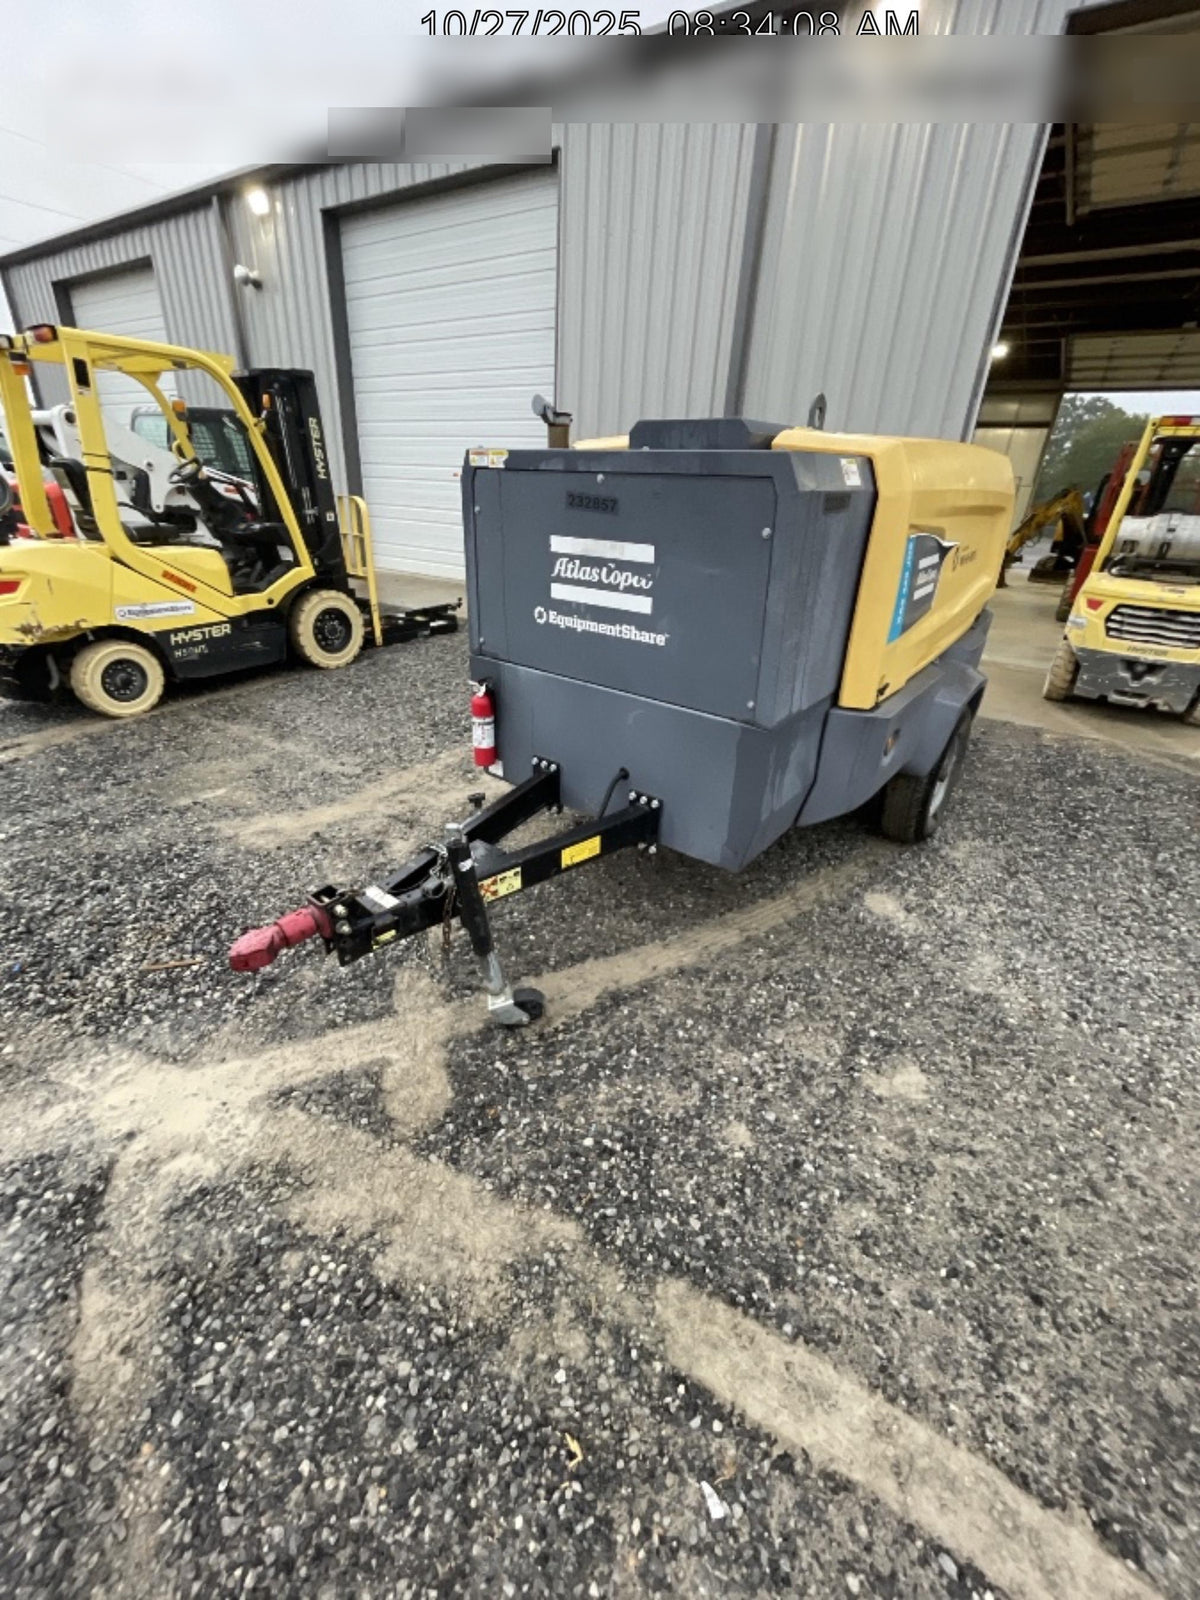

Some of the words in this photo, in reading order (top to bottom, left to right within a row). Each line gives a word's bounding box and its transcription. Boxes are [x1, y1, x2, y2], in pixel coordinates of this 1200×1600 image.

[308, 417, 327, 479] HYSTER
[567, 493, 618, 512] 232857
[551, 557, 600, 582] Atlas
[170, 623, 231, 646] HYSTER
[548, 609, 666, 646] EquipmentShare
